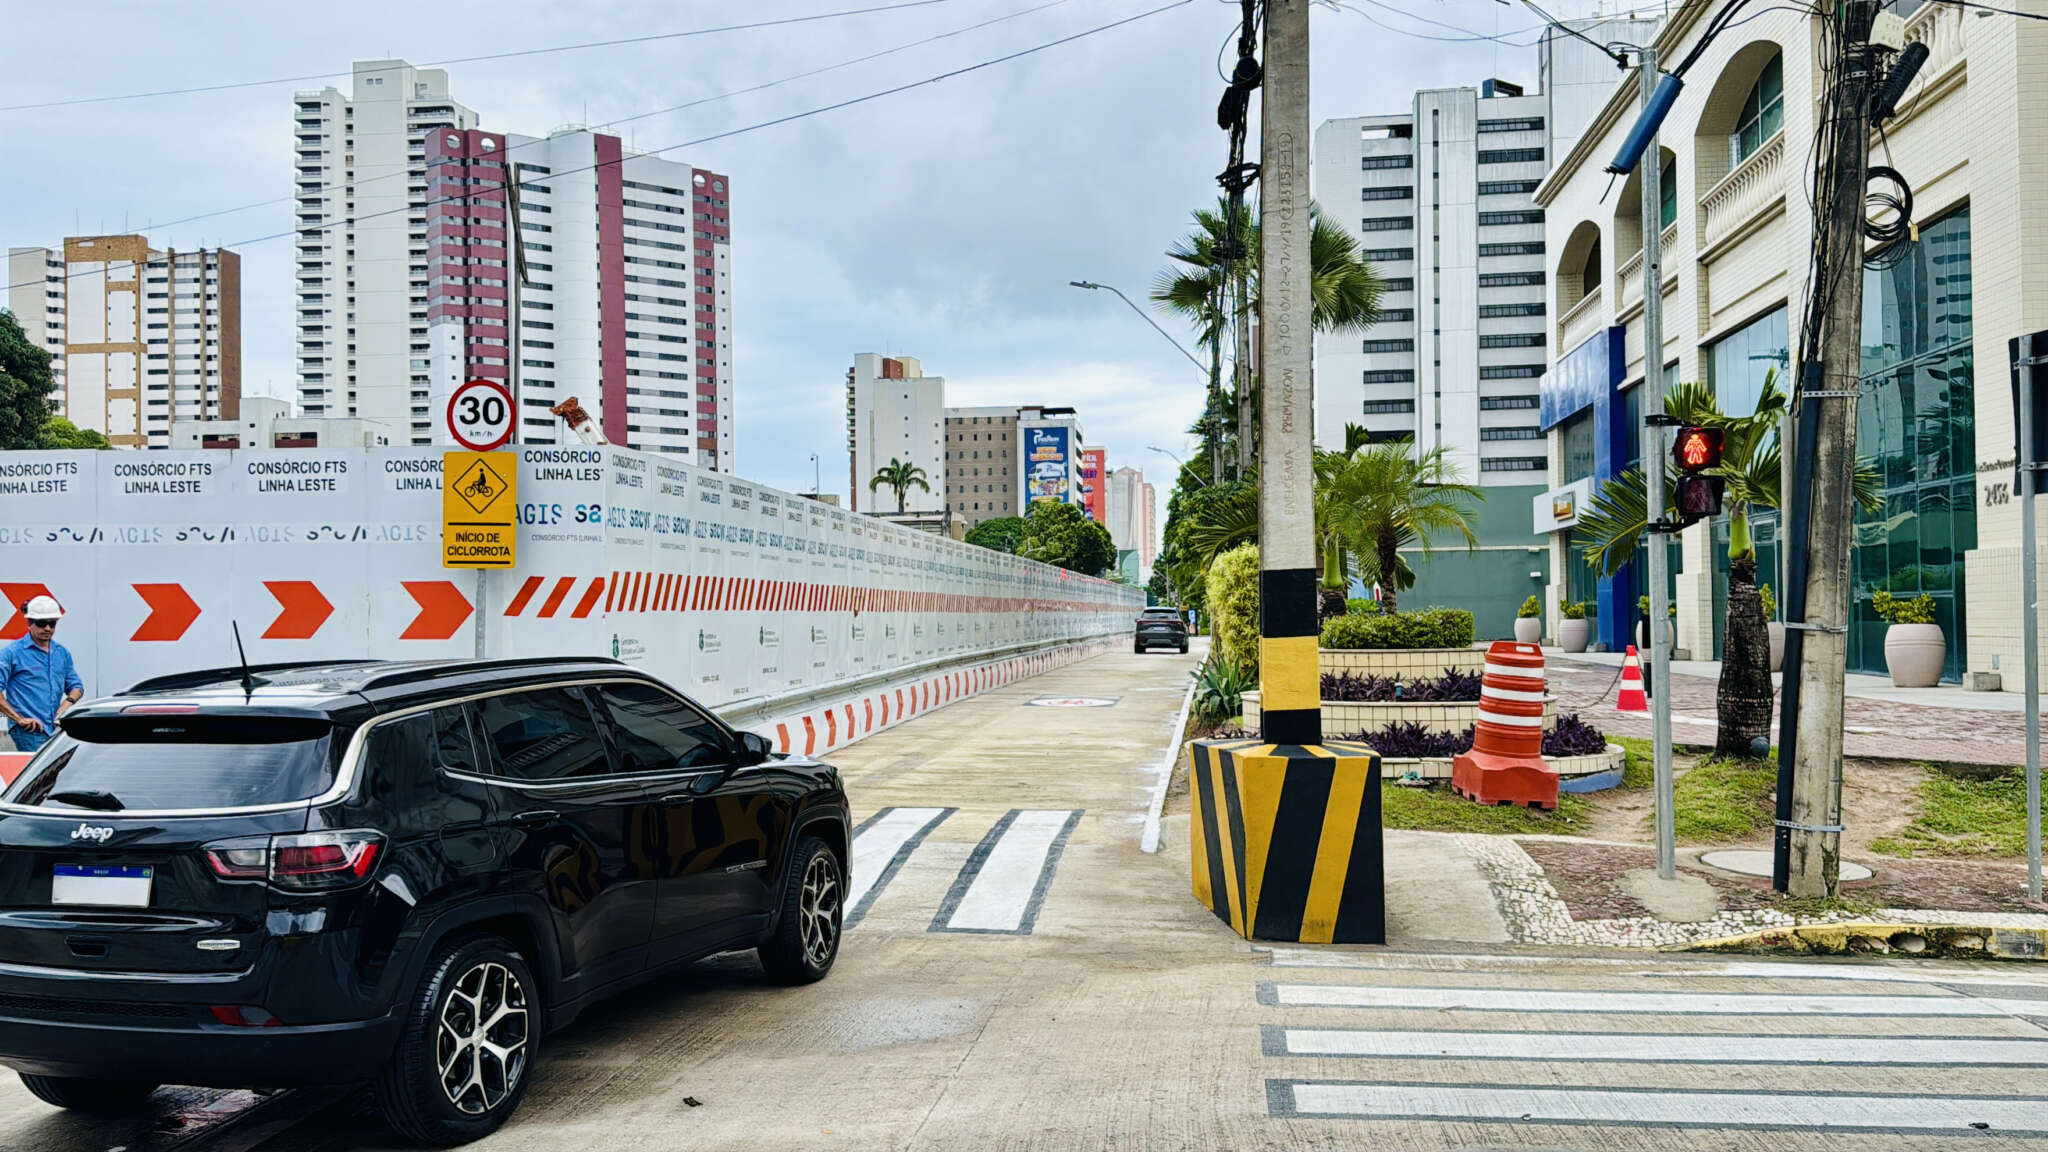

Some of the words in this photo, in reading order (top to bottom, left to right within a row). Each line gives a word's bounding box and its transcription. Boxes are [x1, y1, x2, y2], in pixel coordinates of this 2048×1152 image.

[459, 396, 505, 426] 30
[524, 447, 602, 464] CONSÓRCIO
[56, 462, 78, 475] FTS
[114, 460, 186, 477] CONSÓRCIO
[189, 463, 213, 476] FTS
[247, 459, 321, 475] CONSÓRCIO
[324, 461, 347, 474] FTS
[535, 468, 573, 481] LINHA
[576, 468, 605, 481] LES
[30, 480, 68, 493] LESTE
[124, 481, 160, 494] LINHA
[163, 480, 202, 493] LESTE
[258, 480, 295, 492] LINHA
[298, 479, 336, 491] LESTE
[396, 477, 433, 490] LINHA
[455, 531, 485, 543] INÍCIO
[486, 533, 500, 543] DE
[447, 545, 511, 557] CICLORROTA
[71, 823, 114, 843] Jeep
